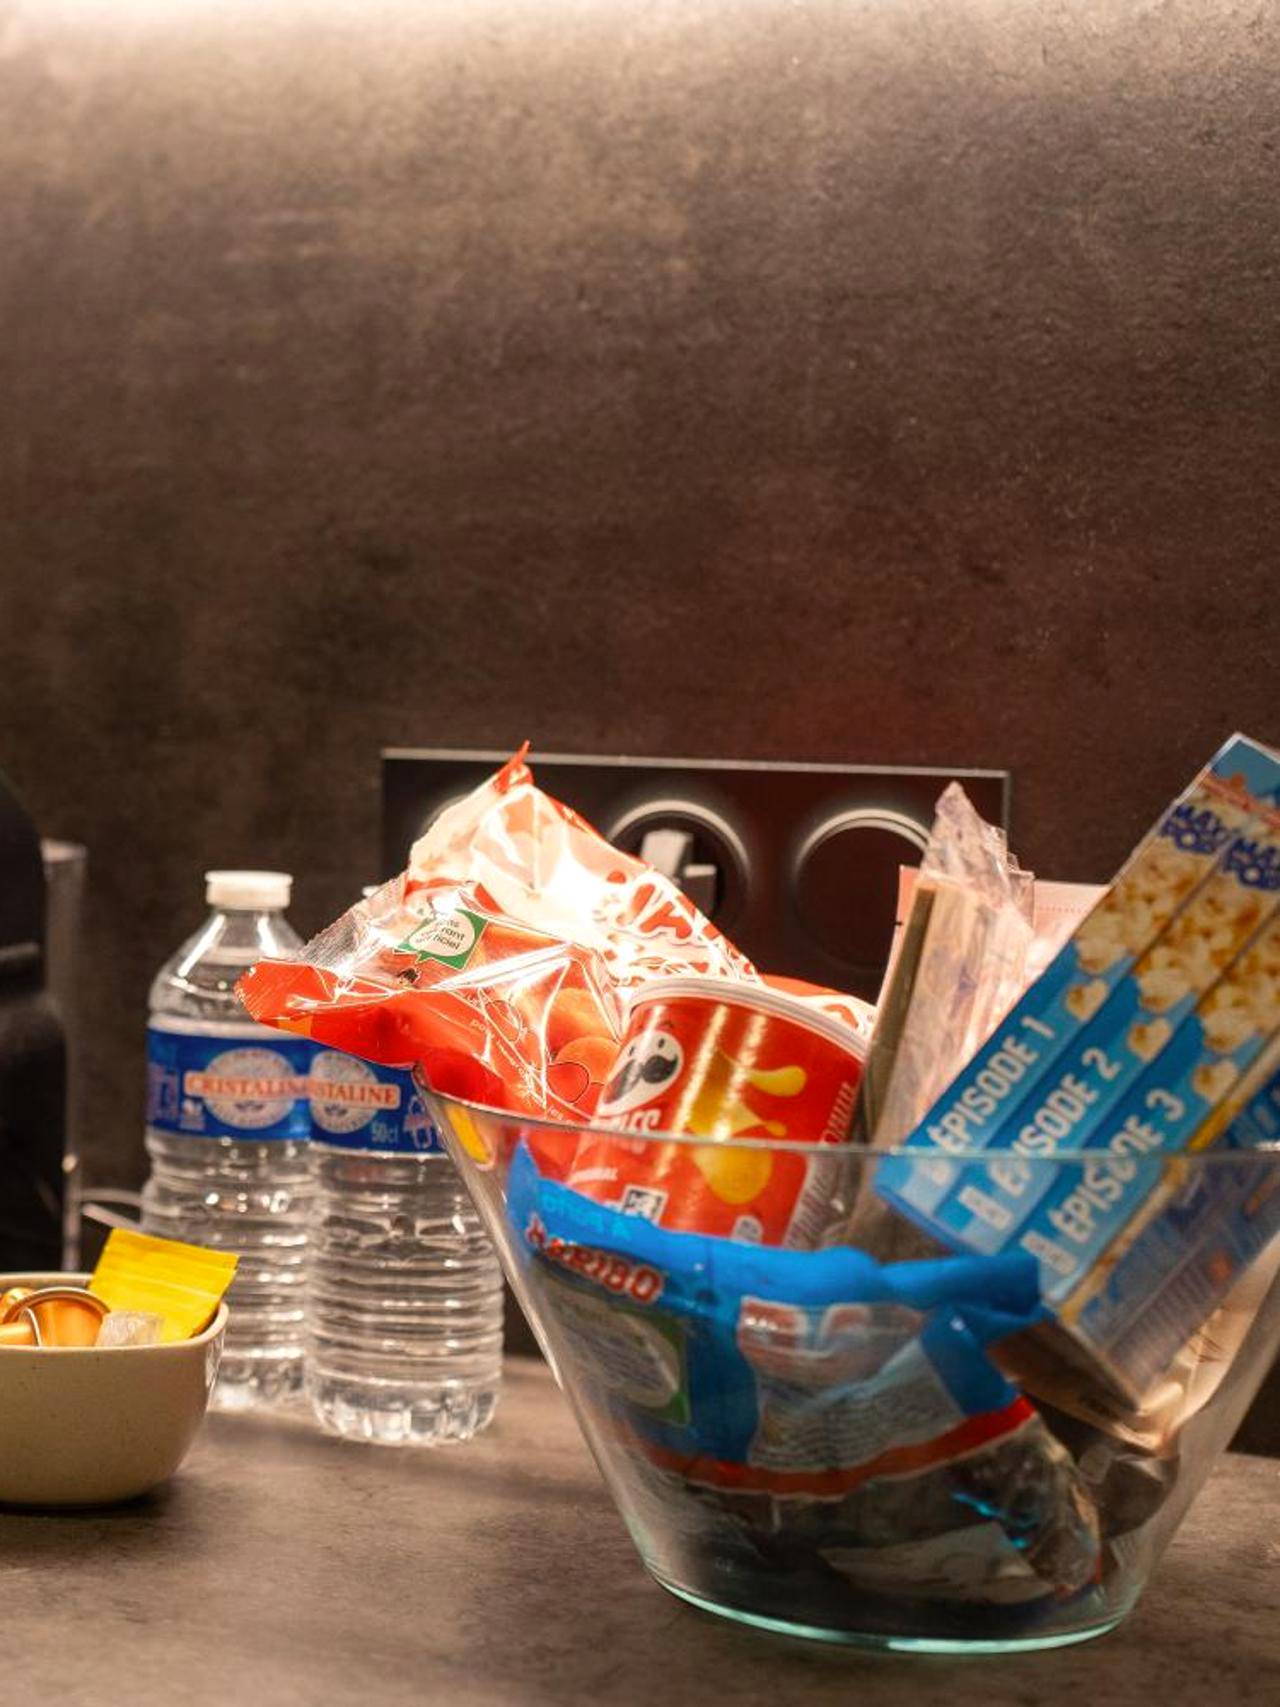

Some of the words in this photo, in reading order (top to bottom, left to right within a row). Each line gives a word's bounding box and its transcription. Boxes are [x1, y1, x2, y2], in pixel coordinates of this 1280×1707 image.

[1021, 1016, 1056, 1039] 1
[1081, 1048, 1121, 1080] 2
[187, 1073, 306, 1097] CRISTALIN
[1145, 1088, 1186, 1121] 3
